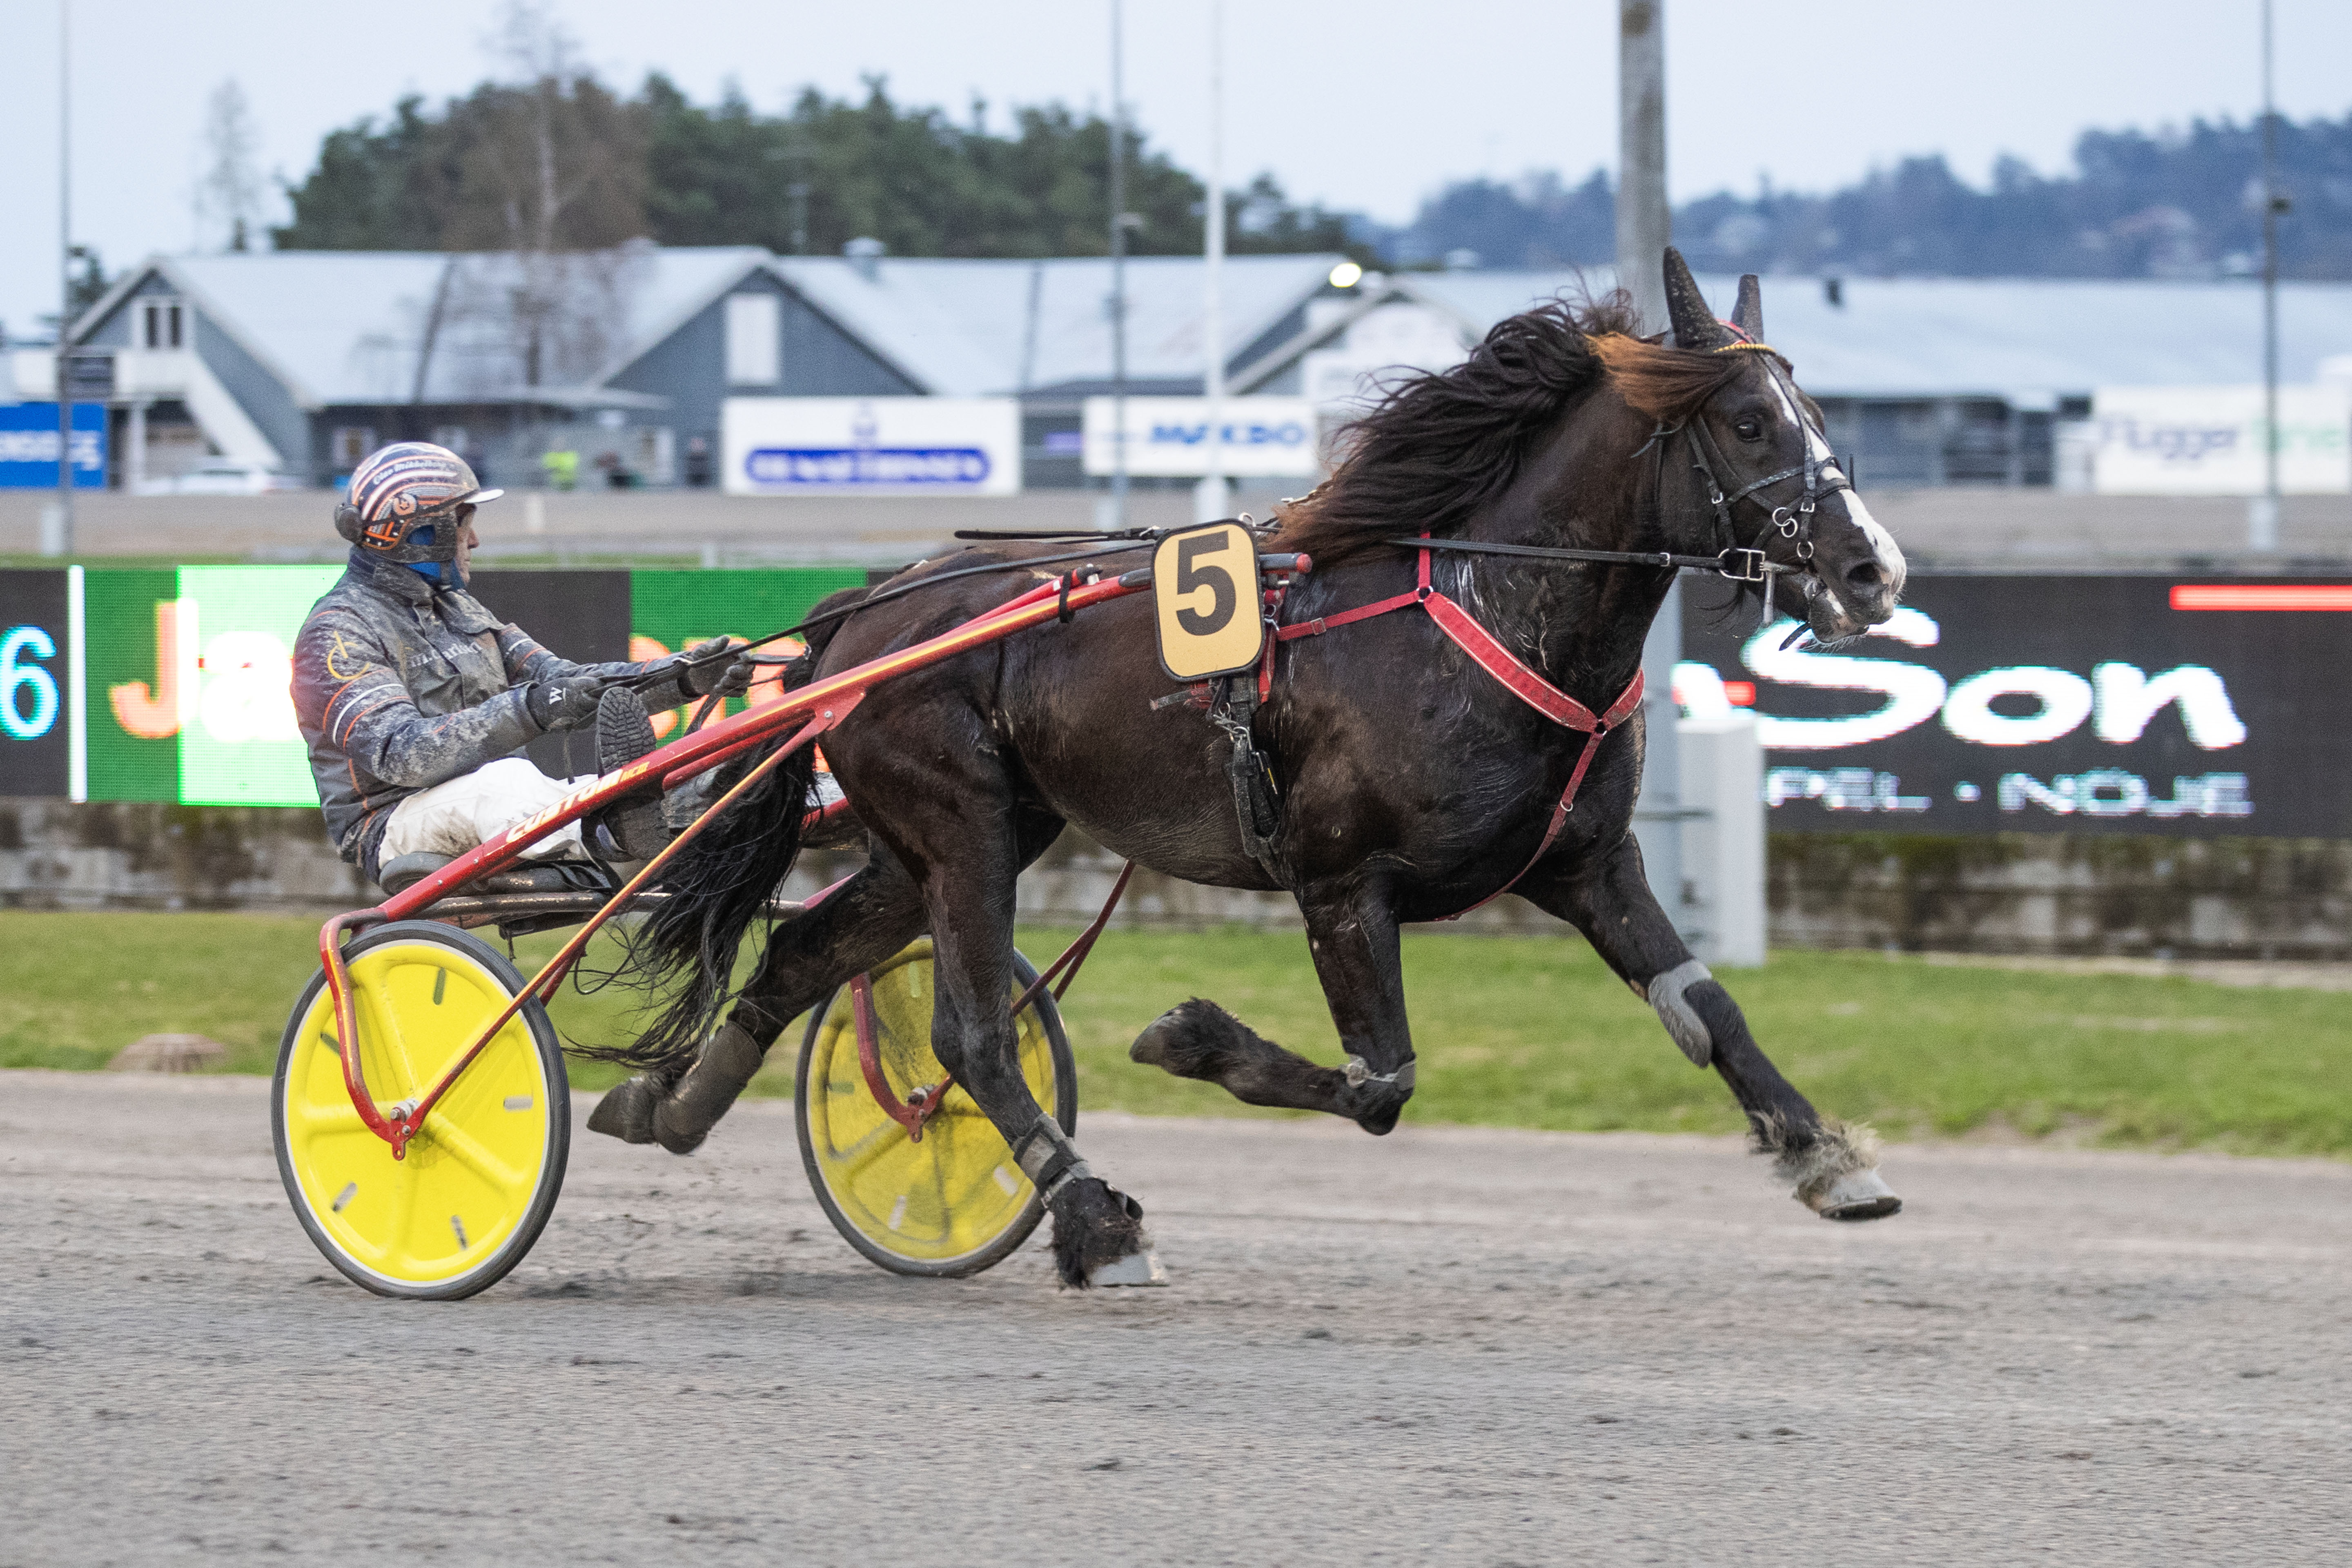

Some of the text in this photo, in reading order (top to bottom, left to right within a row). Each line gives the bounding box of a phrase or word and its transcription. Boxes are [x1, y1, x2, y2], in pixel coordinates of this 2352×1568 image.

[1176, 530, 1236, 636] 5
[0, 625, 60, 740] 6
[1740, 606, 2247, 751] Son
[506, 769, 624, 843] CUSTOM
